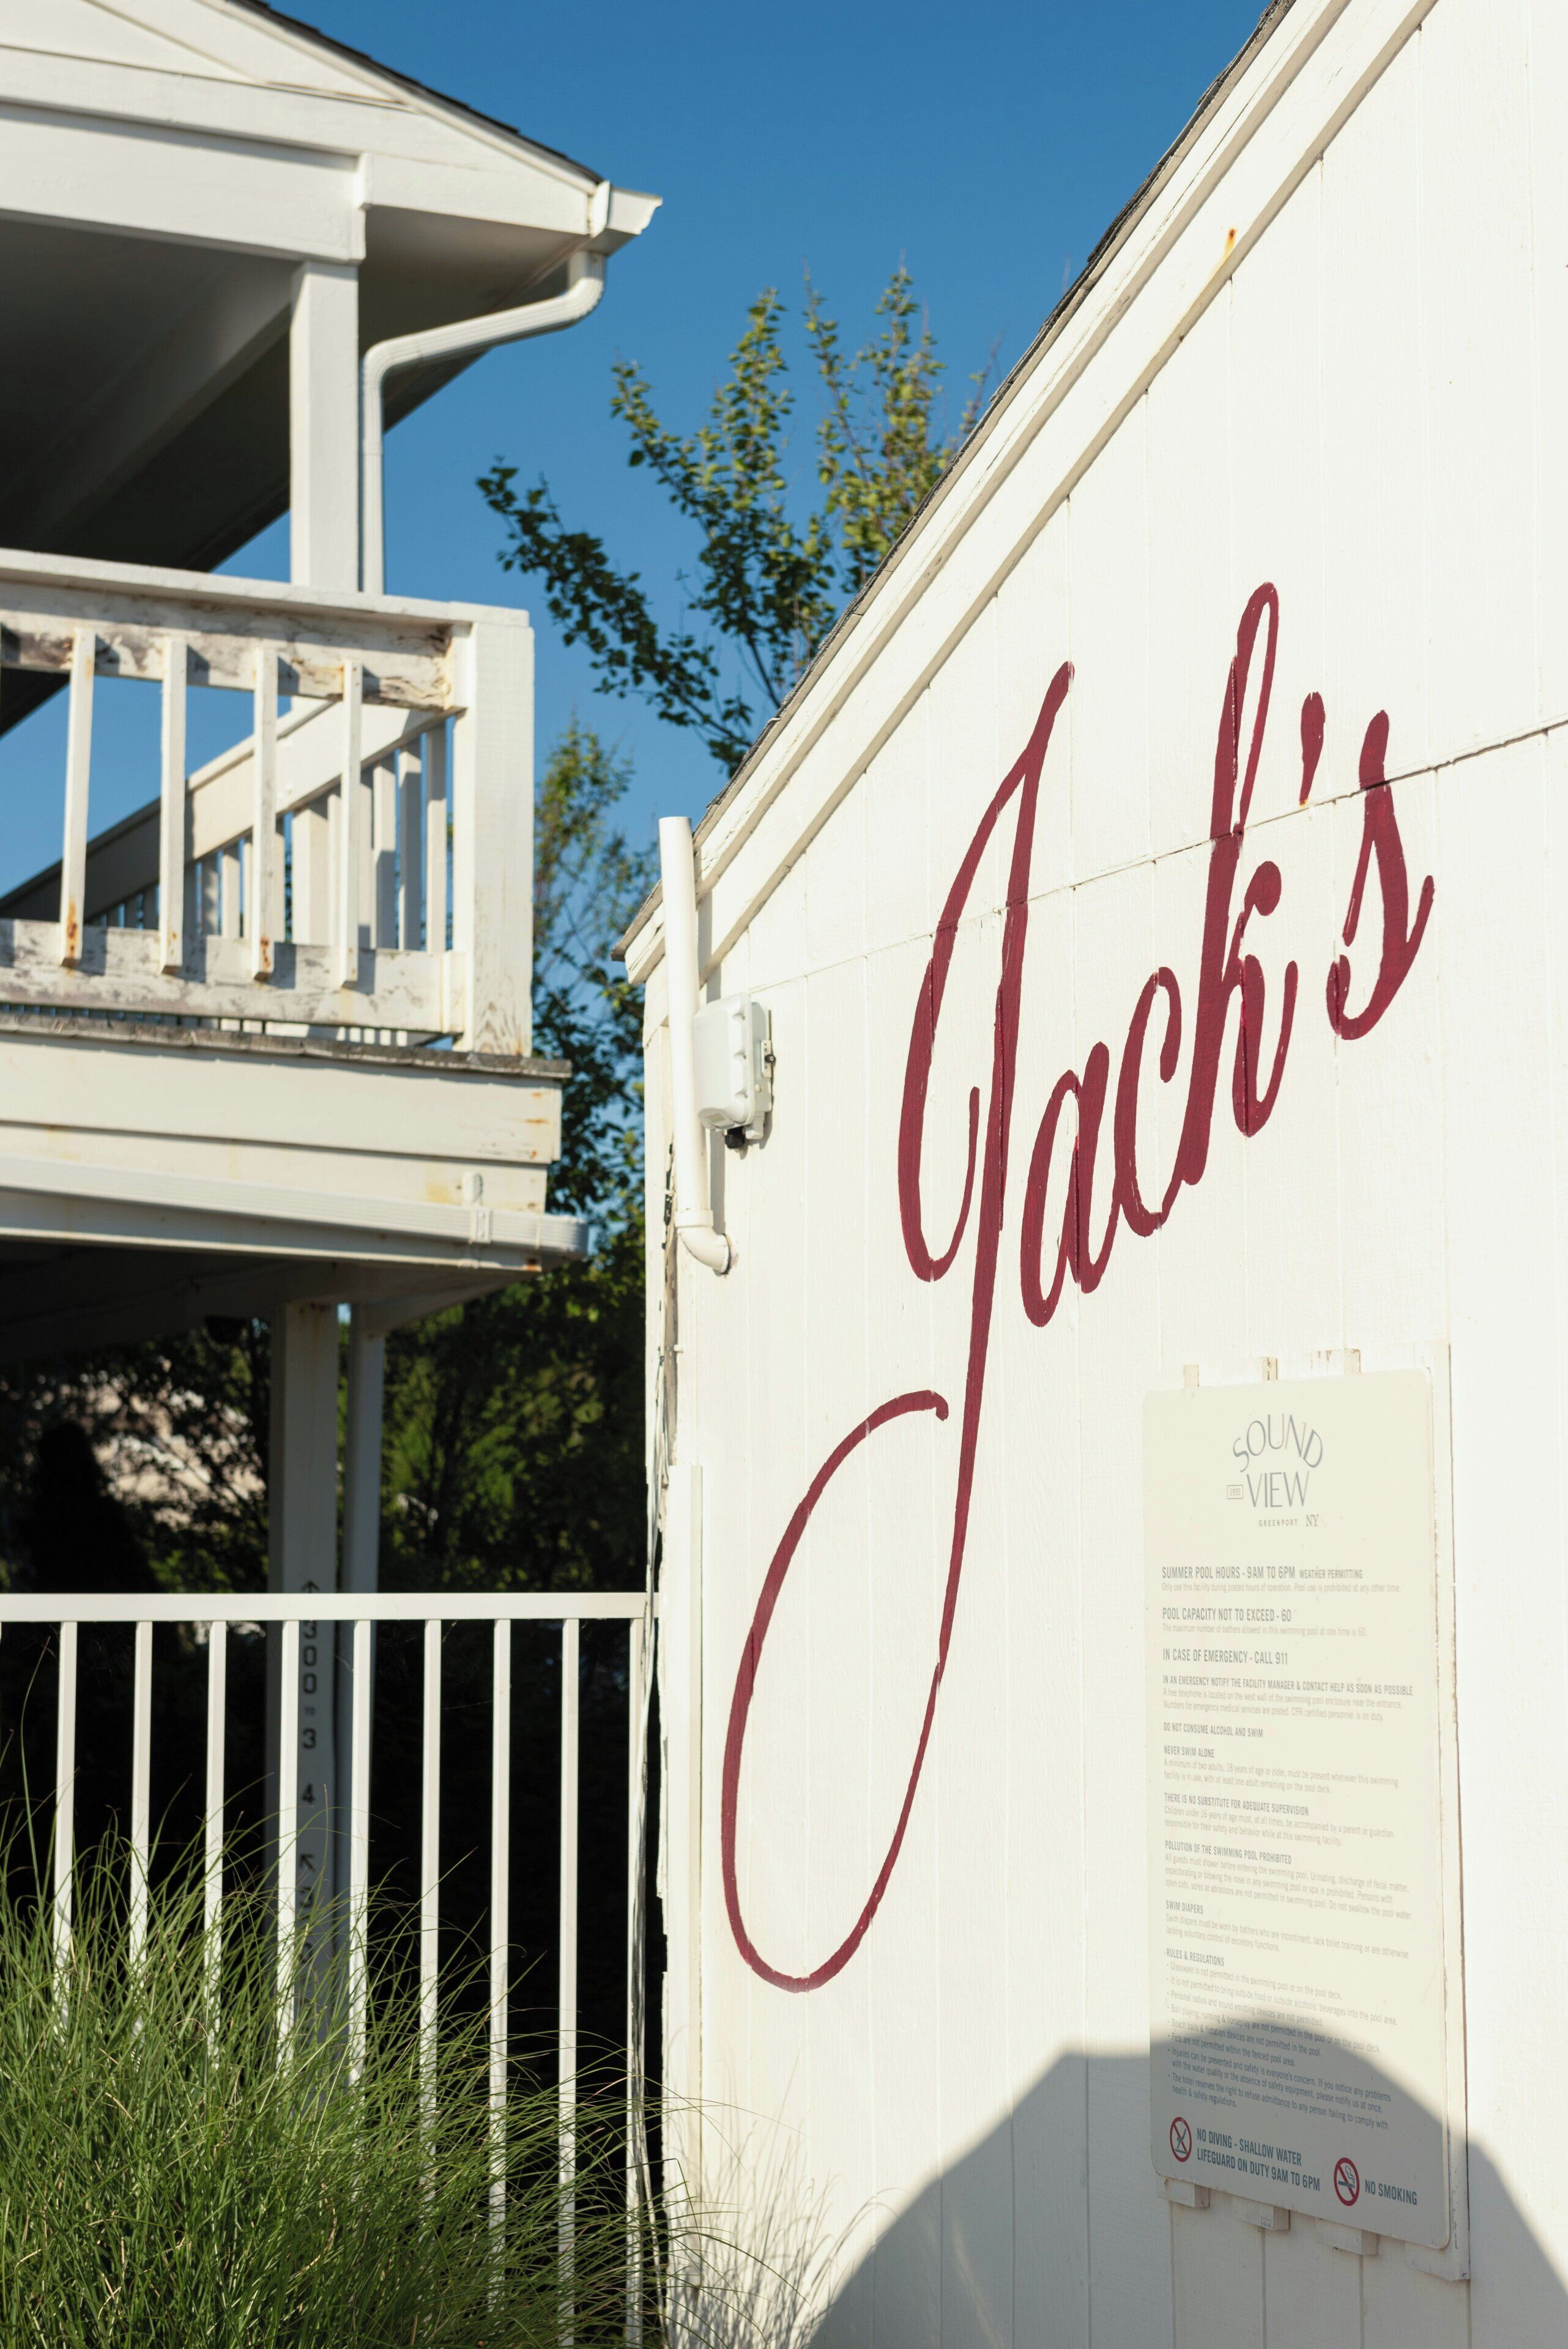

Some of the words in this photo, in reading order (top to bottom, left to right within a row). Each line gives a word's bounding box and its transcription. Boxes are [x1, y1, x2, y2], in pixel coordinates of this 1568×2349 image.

[722, 582, 1435, 1993] Jack's
[1233, 1413, 1323, 1473] SOUND
[1246, 1470, 1310, 1508] VIEW
[1306, 1514, 1320, 1527] NY
[1162, 1566, 1193, 1579] SUMMER
[1195, 1566, 1213, 1579] POOL
[1215, 1566, 1240, 1579] HOURS
[1247, 1566, 1264, 1579] 9AM
[1266, 1566, 1276, 1579] TO
[1278, 1566, 1296, 1579] 6PM
[1298, 1569, 1326, 1579] WEATHER
[1327, 1569, 1363, 1579] PERMITTING
[1162, 1608, 1179, 1620] POOL
[1182, 1608, 1216, 1620] CAPACITY
[1217, 1608, 1232, 1621] NOT
[1235, 1609, 1244, 1621] TO
[1246, 1609, 1275, 1621] EXCEED
[1281, 1609, 1291, 1622] 60
[1162, 1648, 1170, 1660] IN
[1172, 1649, 1191, 1661] CASE
[1192, 1649, 1202, 1661] OF
[1203, 1649, 1247, 1663] EMERGENCY
[1254, 1651, 1273, 1664] CALL
[1275, 1652, 1288, 1664] 911
[1162, 1675, 1169, 1685] IN
[1170, 1675, 1177, 1685] AN
[1178, 1675, 1209, 1687] EMERGENCY
[1211, 1677, 1229, 1687] NOTIFY
[1231, 1678, 1241, 1688] THE
[1243, 1679, 1266, 1689] FACILITY
[1267, 1679, 1295, 1690] MANAGER
[1296, 1680, 1301, 1690] &
[1302, 1681, 1328, 1691] CONTACT
[1329, 1682, 1345, 1692] HELP
[1346, 1683, 1354, 1693] AS
[1356, 1683, 1372, 1694] SOON
[1373, 1683, 1382, 1694] AS
[1383, 1684, 1413, 1695] POSSIBLE
[1163, 1722, 1170, 1732] DO
[1172, 1723, 1181, 1732] NOT
[1183, 1724, 1209, 1734] CONSUME
[1210, 1725, 1233, 1735] ALCOHOL
[1235, 1727, 1246, 1737] AND
[1247, 1728, 1263, 1737] SWIM
[1164, 1745, 1180, 1756] NEVER
[1181, 1746, 1197, 1757] SWIM
[1198, 1748, 1214, 1758] ALONE
[1165, 1792, 1180, 1803] THERE
[1181, 1794, 1187, 1804] IS
[1188, 1795, 1196, 1805] NO
[1197, 1796, 1229, 1808] SUBSTITUTE
[1230, 1799, 1241, 1809] FOR
[1242, 1800, 1270, 1812] ADEQUATE
[1271, 1803, 1309, 1816] SUPERVISION
[1165, 1840, 1192, 1853] POLLUTION
[1194, 1844, 1200, 1854] OF
[1202, 1845, 1211, 1855] THE
[1213, 1846, 1243, 1858] SWIMMING
[1244, 1849, 1257, 1860] POOL
[1259, 1851, 1292, 1864] PROHIBITED
[1165, 1900, 1181, 1911] SWIM
[1181, 1902, 1203, 1914] DIAPERS
[1166, 1948, 1182, 1960] RULES
[1184, 1951, 1188, 1961] &
[1189, 1951, 1224, 1966] REGULATIONS
[1172, 2047, 1189, 2059] Injuries
[1200, 2054, 1207, 2063] be
[1208, 2057, 1232, 2068] prevented
[1233, 2061, 1243, 2071] and
[1244, 2063, 1259, 2076] safety
[1260, 2066, 1265, 2075] is
[1266, 2069, 1293, 2081] everyone's
[1293, 2075, 1317, 2086] concern.
[1318, 2078, 1323, 2087] If
[1323, 2081, 1334, 2090] you
[1335, 2084, 1352, 2093] notice
[1352, 2087, 1364, 2098] any
[1364, 2090, 1391, 2101] problems
[1172, 2061, 1182, 2069] with
[1206, 2069, 1223, 2080] quality
[1230, 2073, 1239, 2082] the
[1239, 2075, 1260, 2087] absence
[1268, 2082, 1284, 2093] safety
[1284, 2086, 1315, 2098] equipment,
[1316, 2091, 1334, 2102] please
[1335, 2096, 1351, 2107] notify
[1367, 2103, 1383, 2112] once.
[1172, 2086, 1187, 2096] health
[1193, 2091, 1208, 2102] safety
[1208, 2095, 1237, 2107] regulations.
[1173, 2073, 1181, 2083] The
[1182, 2075, 1194, 2086] hotel
[1195, 2080, 1215, 2090] reserves
[1216, 2083, 1224, 2093] the
[1225, 2085, 1237, 2096] right
[1238, 2088, 1244, 2097] to
[1244, 2090, 1260, 2101] refuse
[1261, 2093, 1290, 2107] admittance
[1298, 2103, 1308, 2113] any
[1309, 2106, 1328, 2115] person
[1328, 2108, 1346, 2121] failing
[1346, 2113, 1353, 2121] to
[1354, 2115, 1375, 2128] comply
[1375, 2120, 1388, 2129] with
[1197, 2128, 1206, 2143] NO
[1208, 2131, 1232, 2149] DIVING
[1239, 2138, 1274, 2159] SHALLOW
[1276, 2147, 1301, 2166] WATER
[1197, 2147, 1235, 2170] LIFEGUARD
[1237, 2157, 1247, 2173] ON
[1249, 2160, 1269, 2179] DUTY
[1271, 2165, 1288, 2184] 9AM
[1291, 2170, 1300, 2186] TO
[1302, 2173, 1320, 2192] 6PM
[1364, 2179, 1376, 2196] NO
[1378, 2182, 1417, 2205] SMOKING
